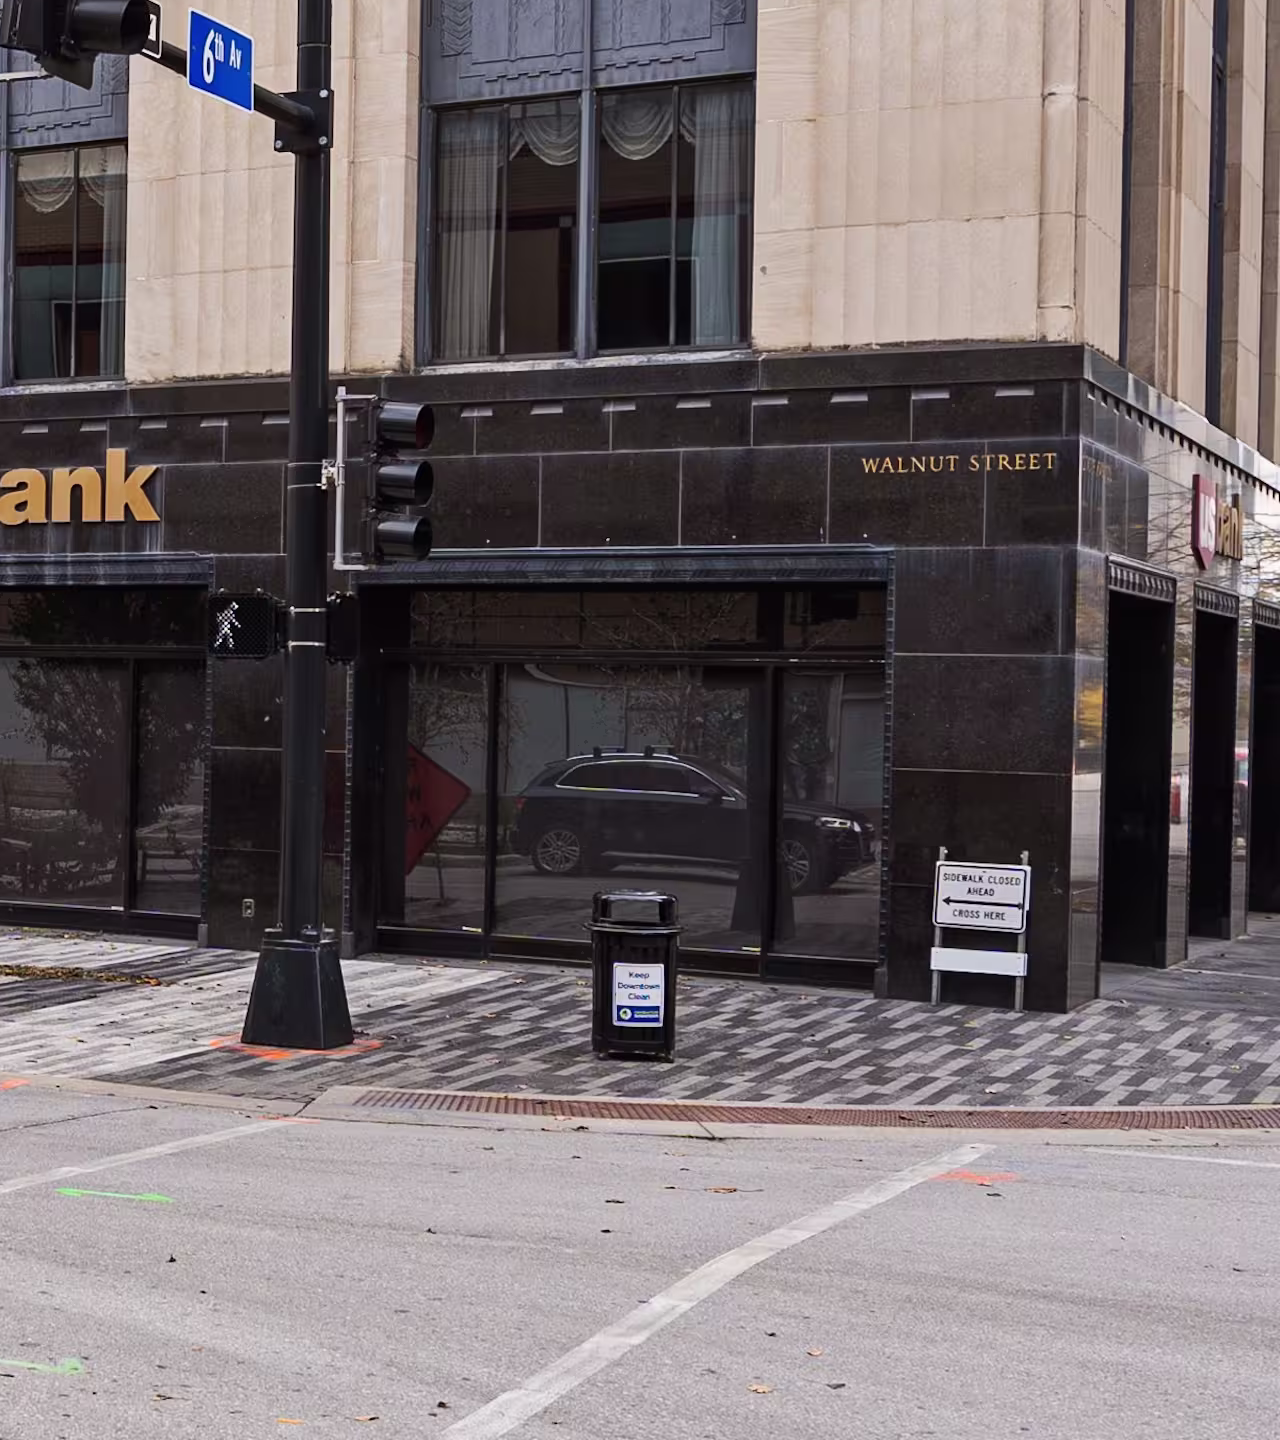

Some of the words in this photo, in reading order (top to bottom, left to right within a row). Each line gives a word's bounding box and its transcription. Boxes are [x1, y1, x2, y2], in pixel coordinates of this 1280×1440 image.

[203, 29, 225, 84] 6th
[229, 39, 243, 70] Av
[861, 454, 960, 474] WALNUT
[968, 452, 1058, 472] STREET
[942, 872, 985, 885] SIDEWALK
[987, 875, 1021, 886] CLOSED
[966, 887, 995, 897] AHEAD
[952, 908, 980, 920] CROSS
[983, 911, 1007, 921] HERE
[628, 971, 651, 981] Keep
[617, 982, 661, 990] Downtown
[627, 992, 651, 1001] Clean
